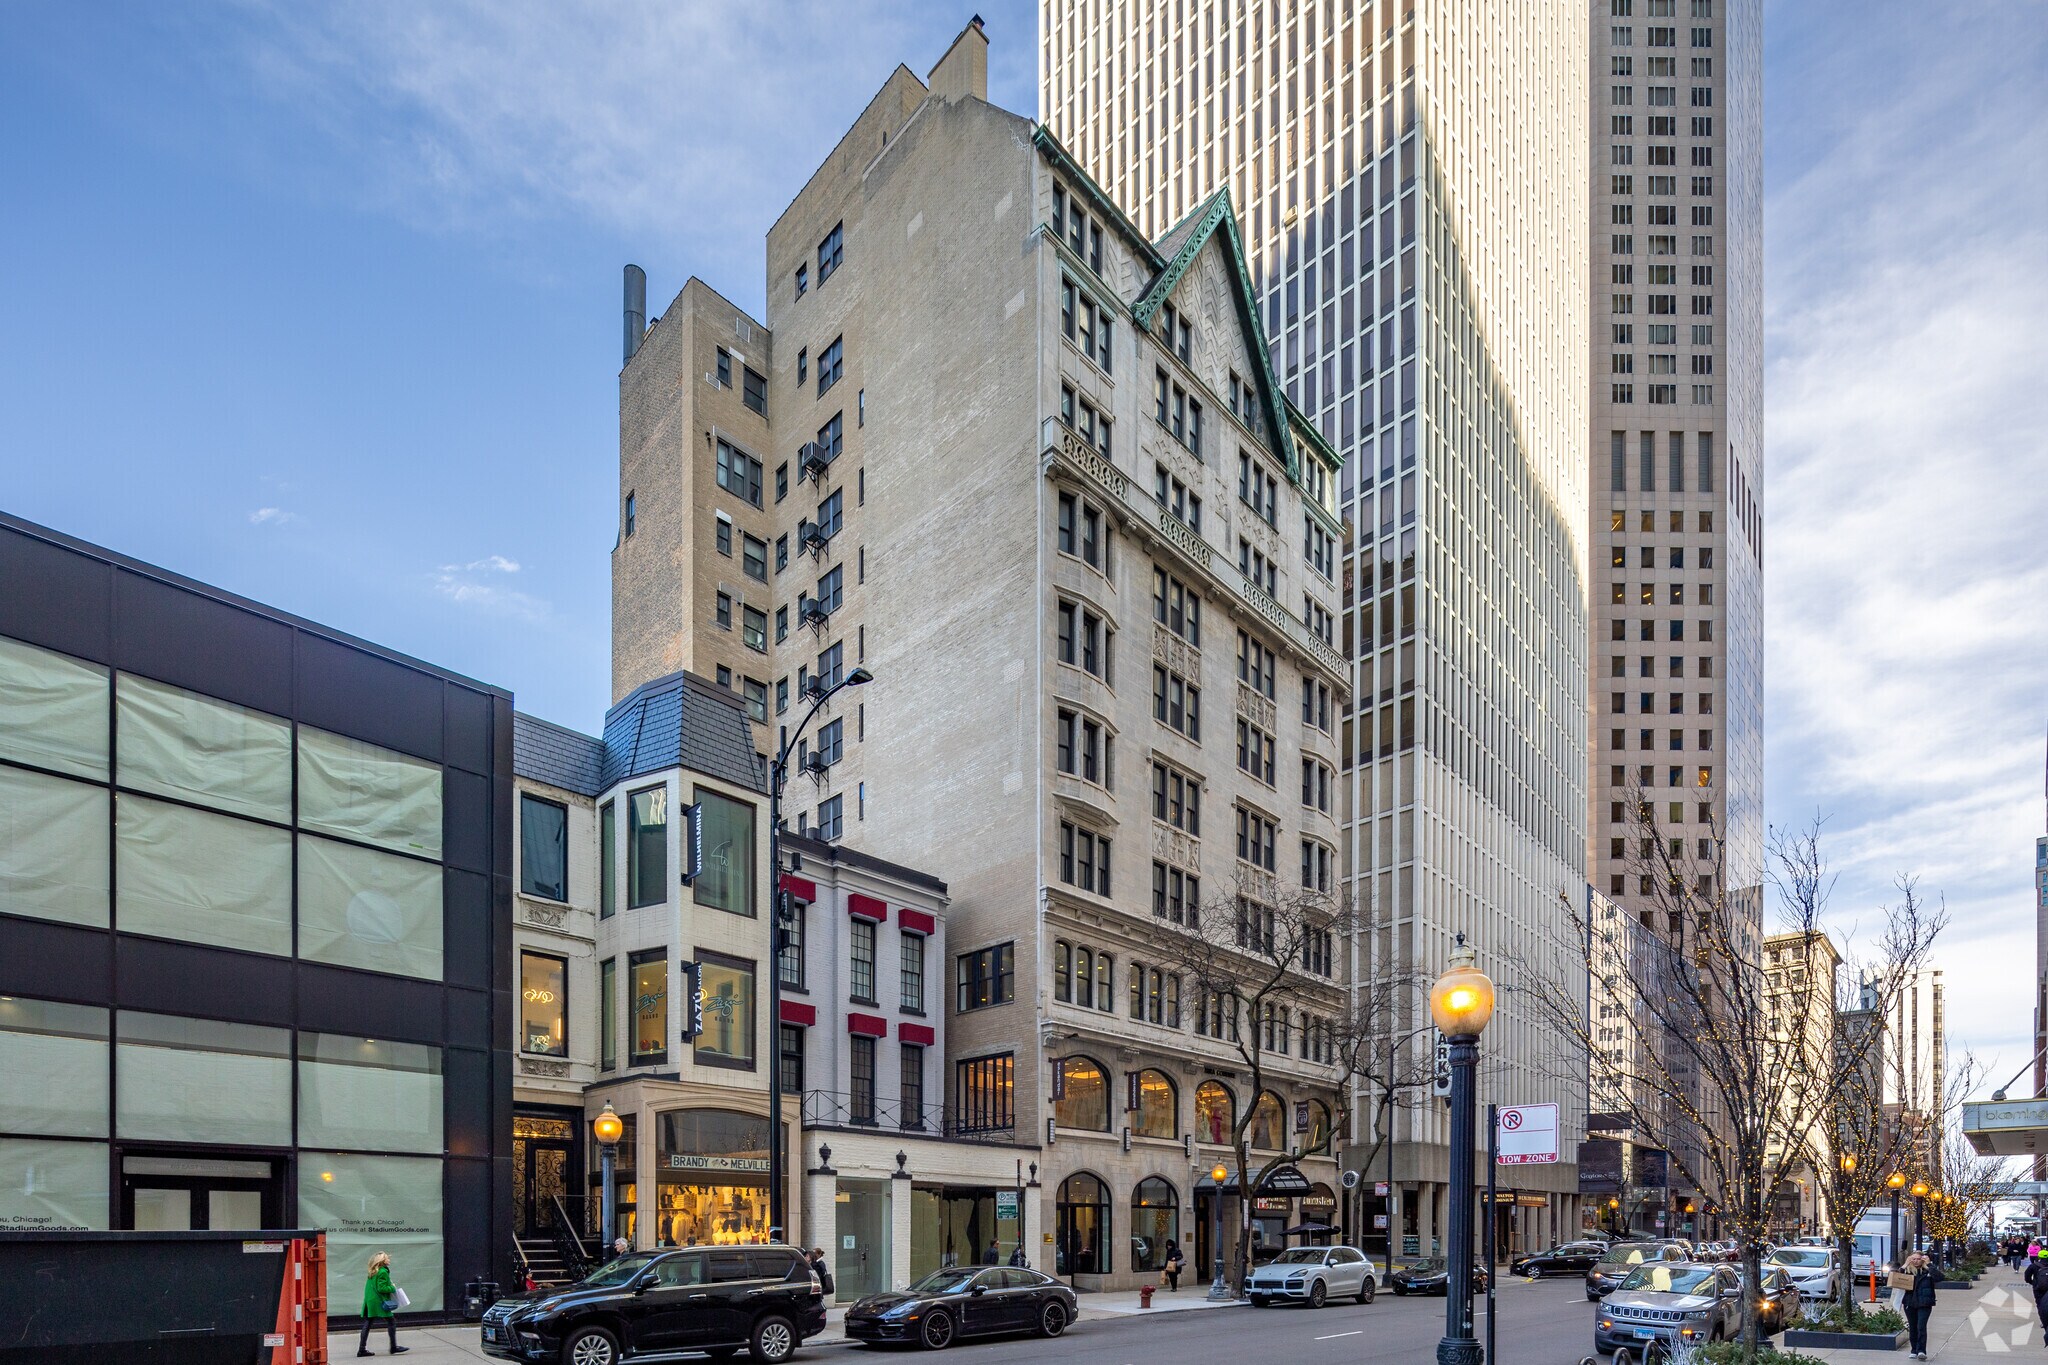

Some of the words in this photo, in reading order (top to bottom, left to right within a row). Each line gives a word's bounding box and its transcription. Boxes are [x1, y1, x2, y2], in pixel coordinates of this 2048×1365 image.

[1437, 1027, 1448, 1073] ARK
[673, 1156, 709, 1167] BRANDY
[730, 1160, 771, 1170] MELVILLE
[1502, 1155, 1521, 1163] TOW
[1527, 1153, 1552, 1162] ZONE
